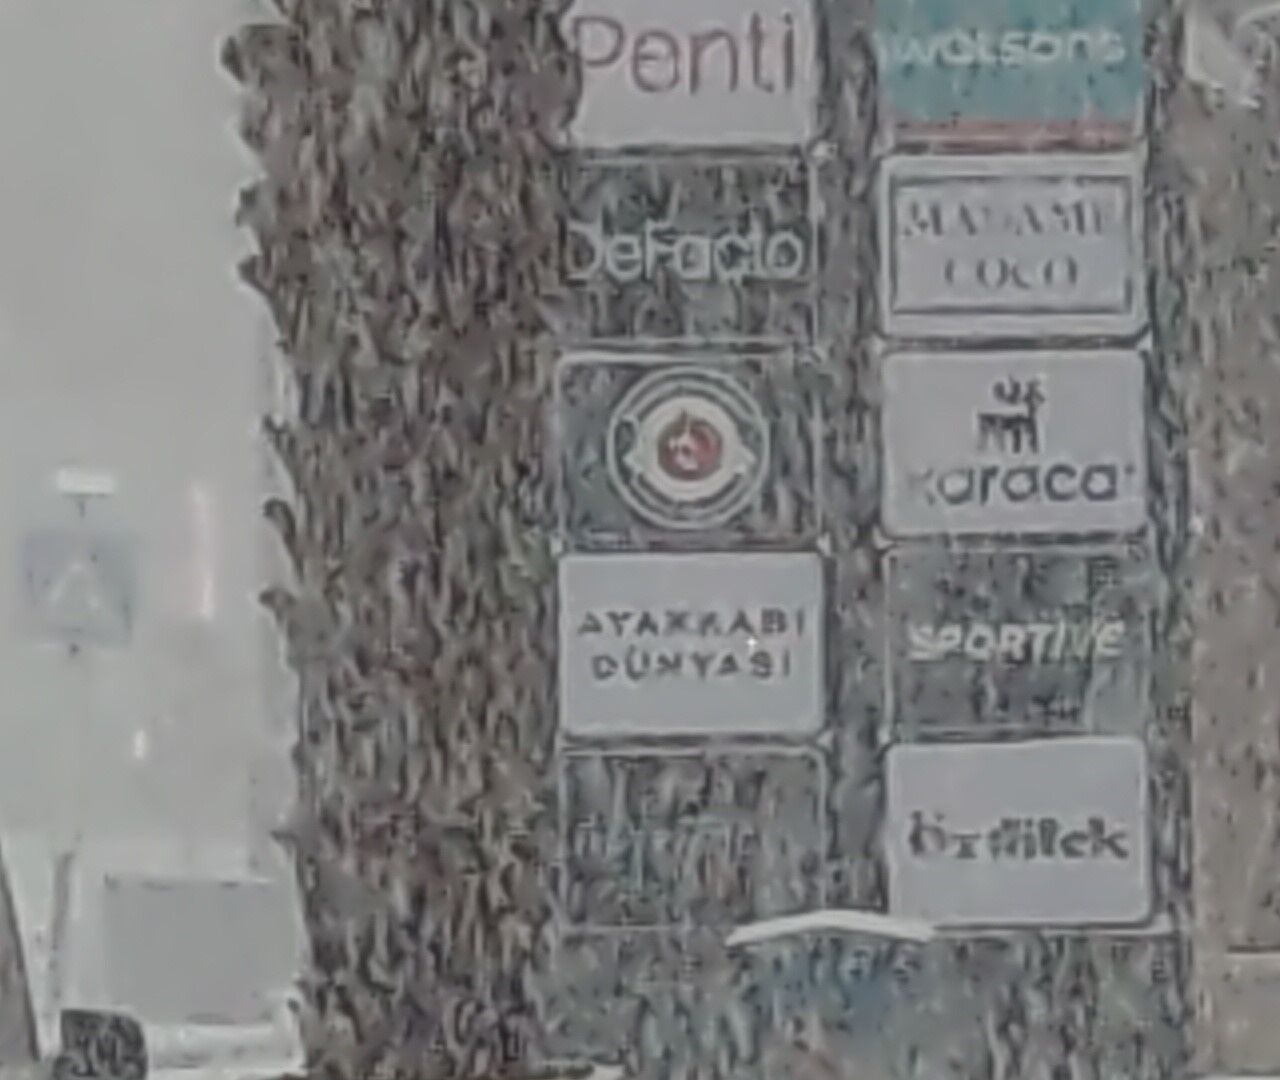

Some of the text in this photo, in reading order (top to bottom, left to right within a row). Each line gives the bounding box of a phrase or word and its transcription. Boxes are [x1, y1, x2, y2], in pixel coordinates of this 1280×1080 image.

[572, 11, 795, 94] Penti
[902, 200, 1114, 237] MAAM
[577, 608, 806, 637] AYAKKABI
[592, 645, 793, 681] DÜNYASI
